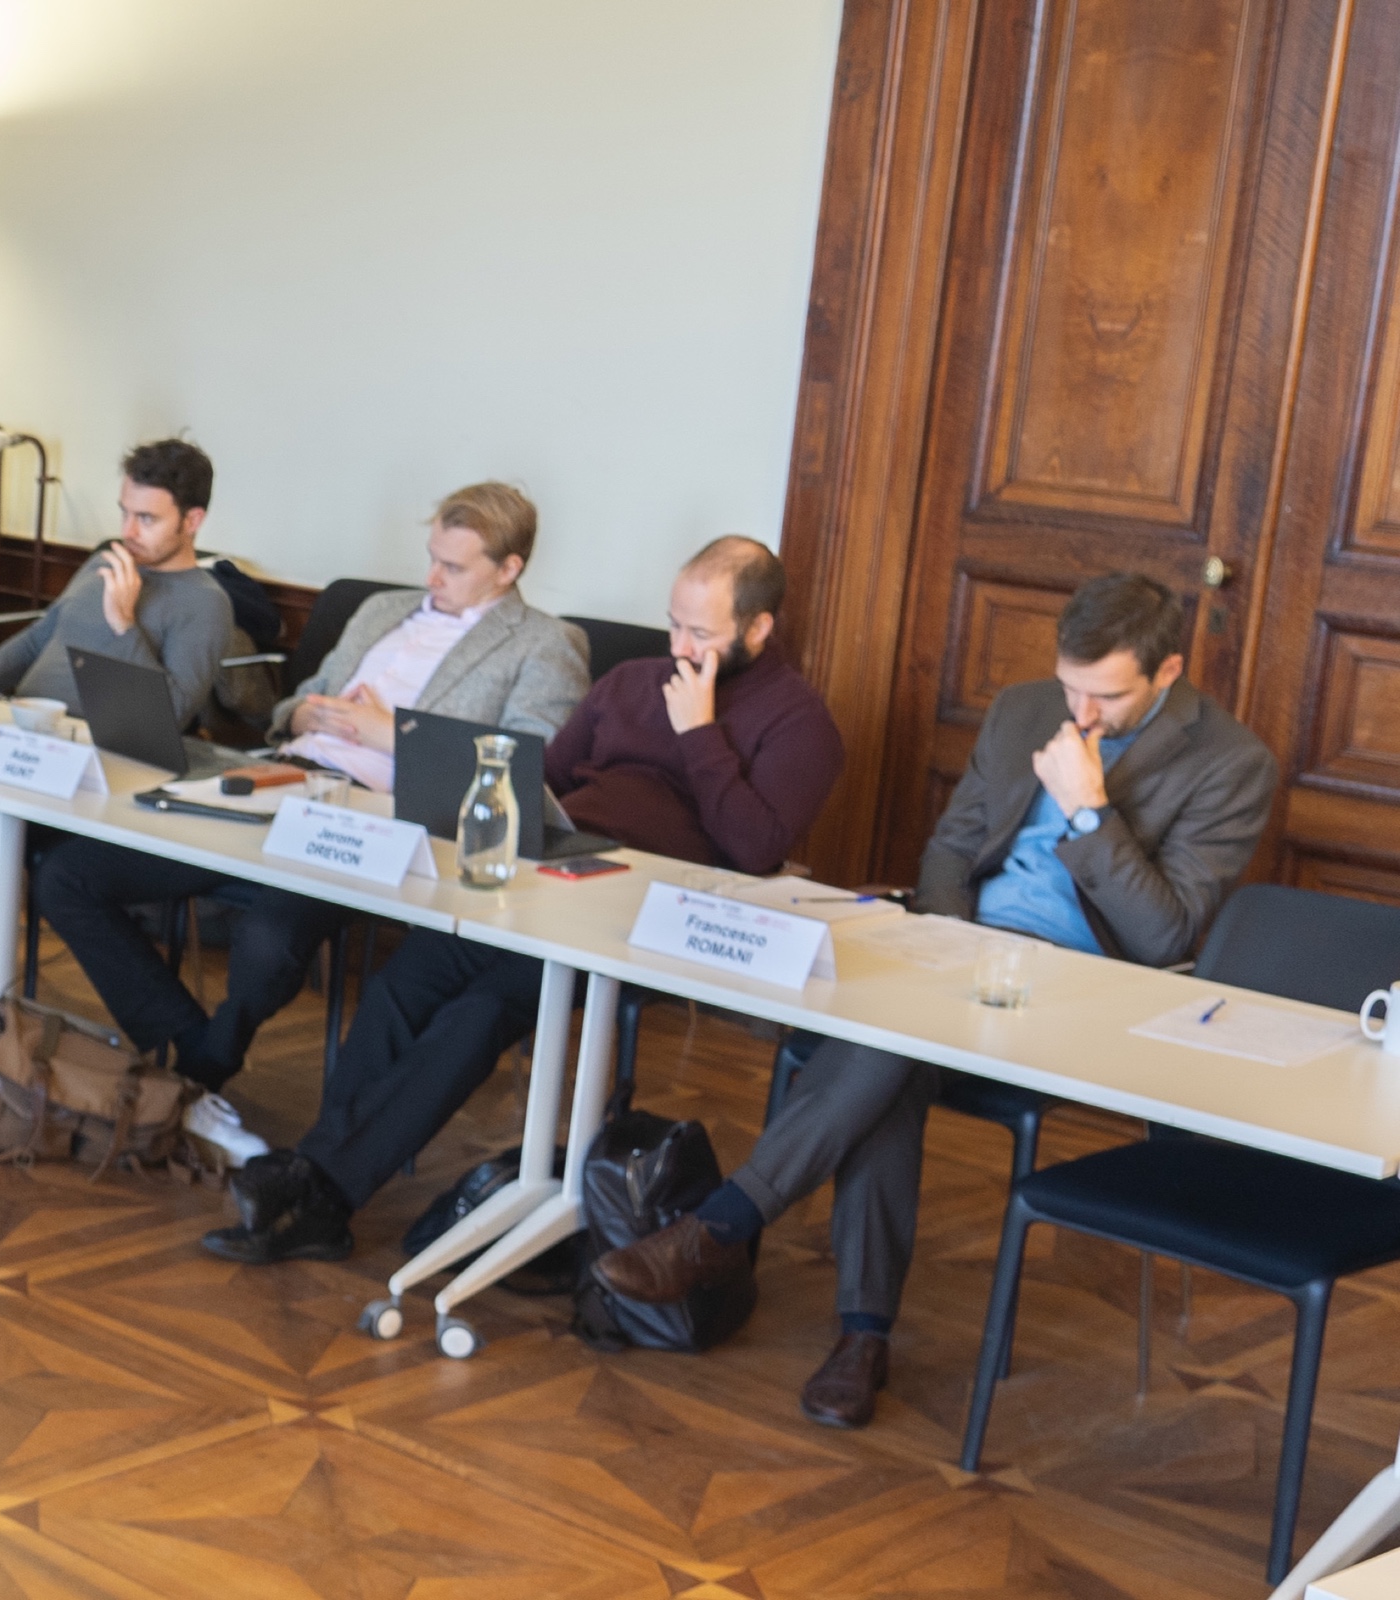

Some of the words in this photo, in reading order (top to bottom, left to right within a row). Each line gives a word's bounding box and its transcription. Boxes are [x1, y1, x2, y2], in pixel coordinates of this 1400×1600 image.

[317, 827, 364, 848] Jerome
[305, 842, 361, 866] DREVON
[685, 914, 768, 948] Francesco
[685, 935, 753, 965] ROMANI
